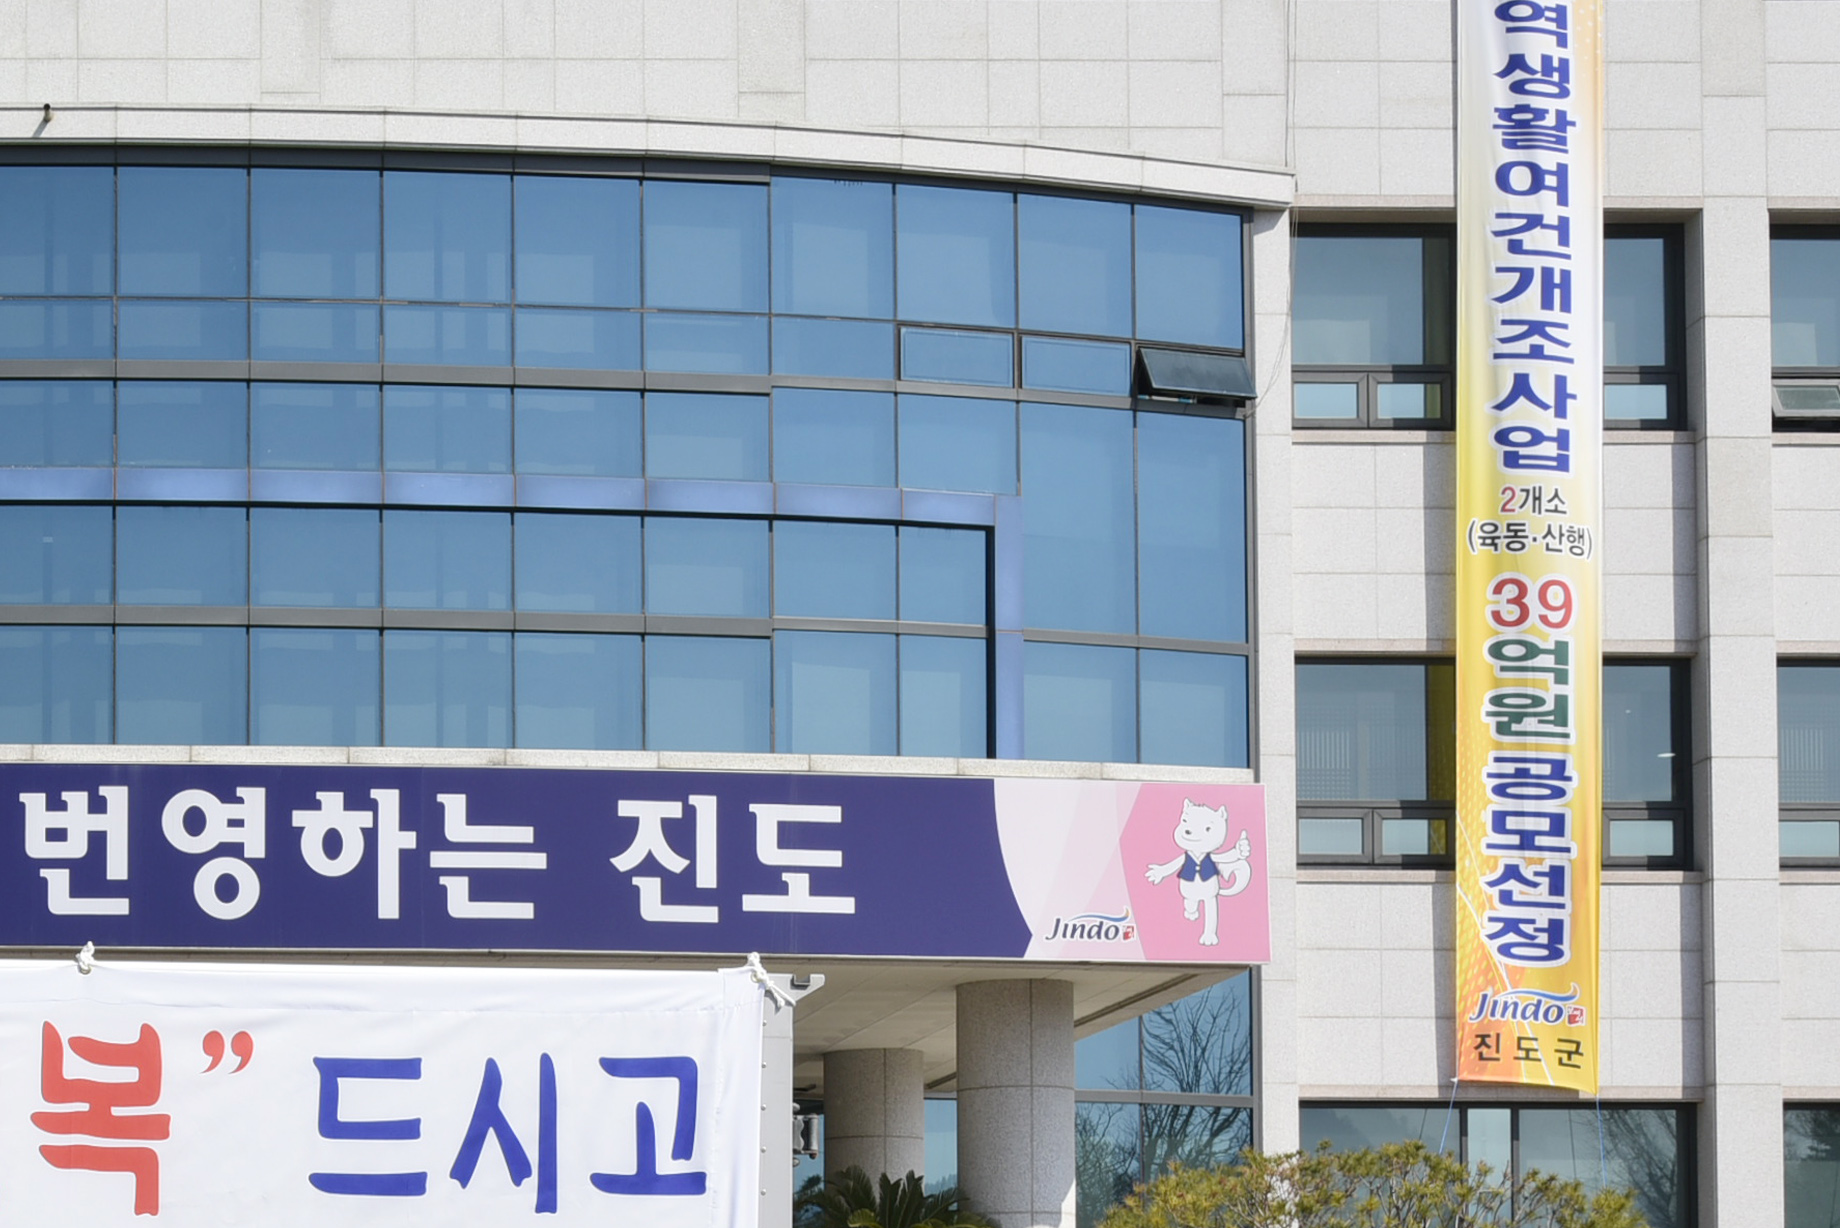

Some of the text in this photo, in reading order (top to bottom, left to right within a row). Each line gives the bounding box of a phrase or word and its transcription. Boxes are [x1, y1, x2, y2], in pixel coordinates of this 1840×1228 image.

[1500, 485, 1568, 516] 2개소
[19, 785, 547, 920] 번영하는
[609, 794, 856, 923] 진도
[1485, 756, 1574, 962] 공모선정
[1045, 916, 1121, 942] Jindo
[1468, 992, 1565, 1024] Jindo
[309, 1053, 708, 1214] 드시고
